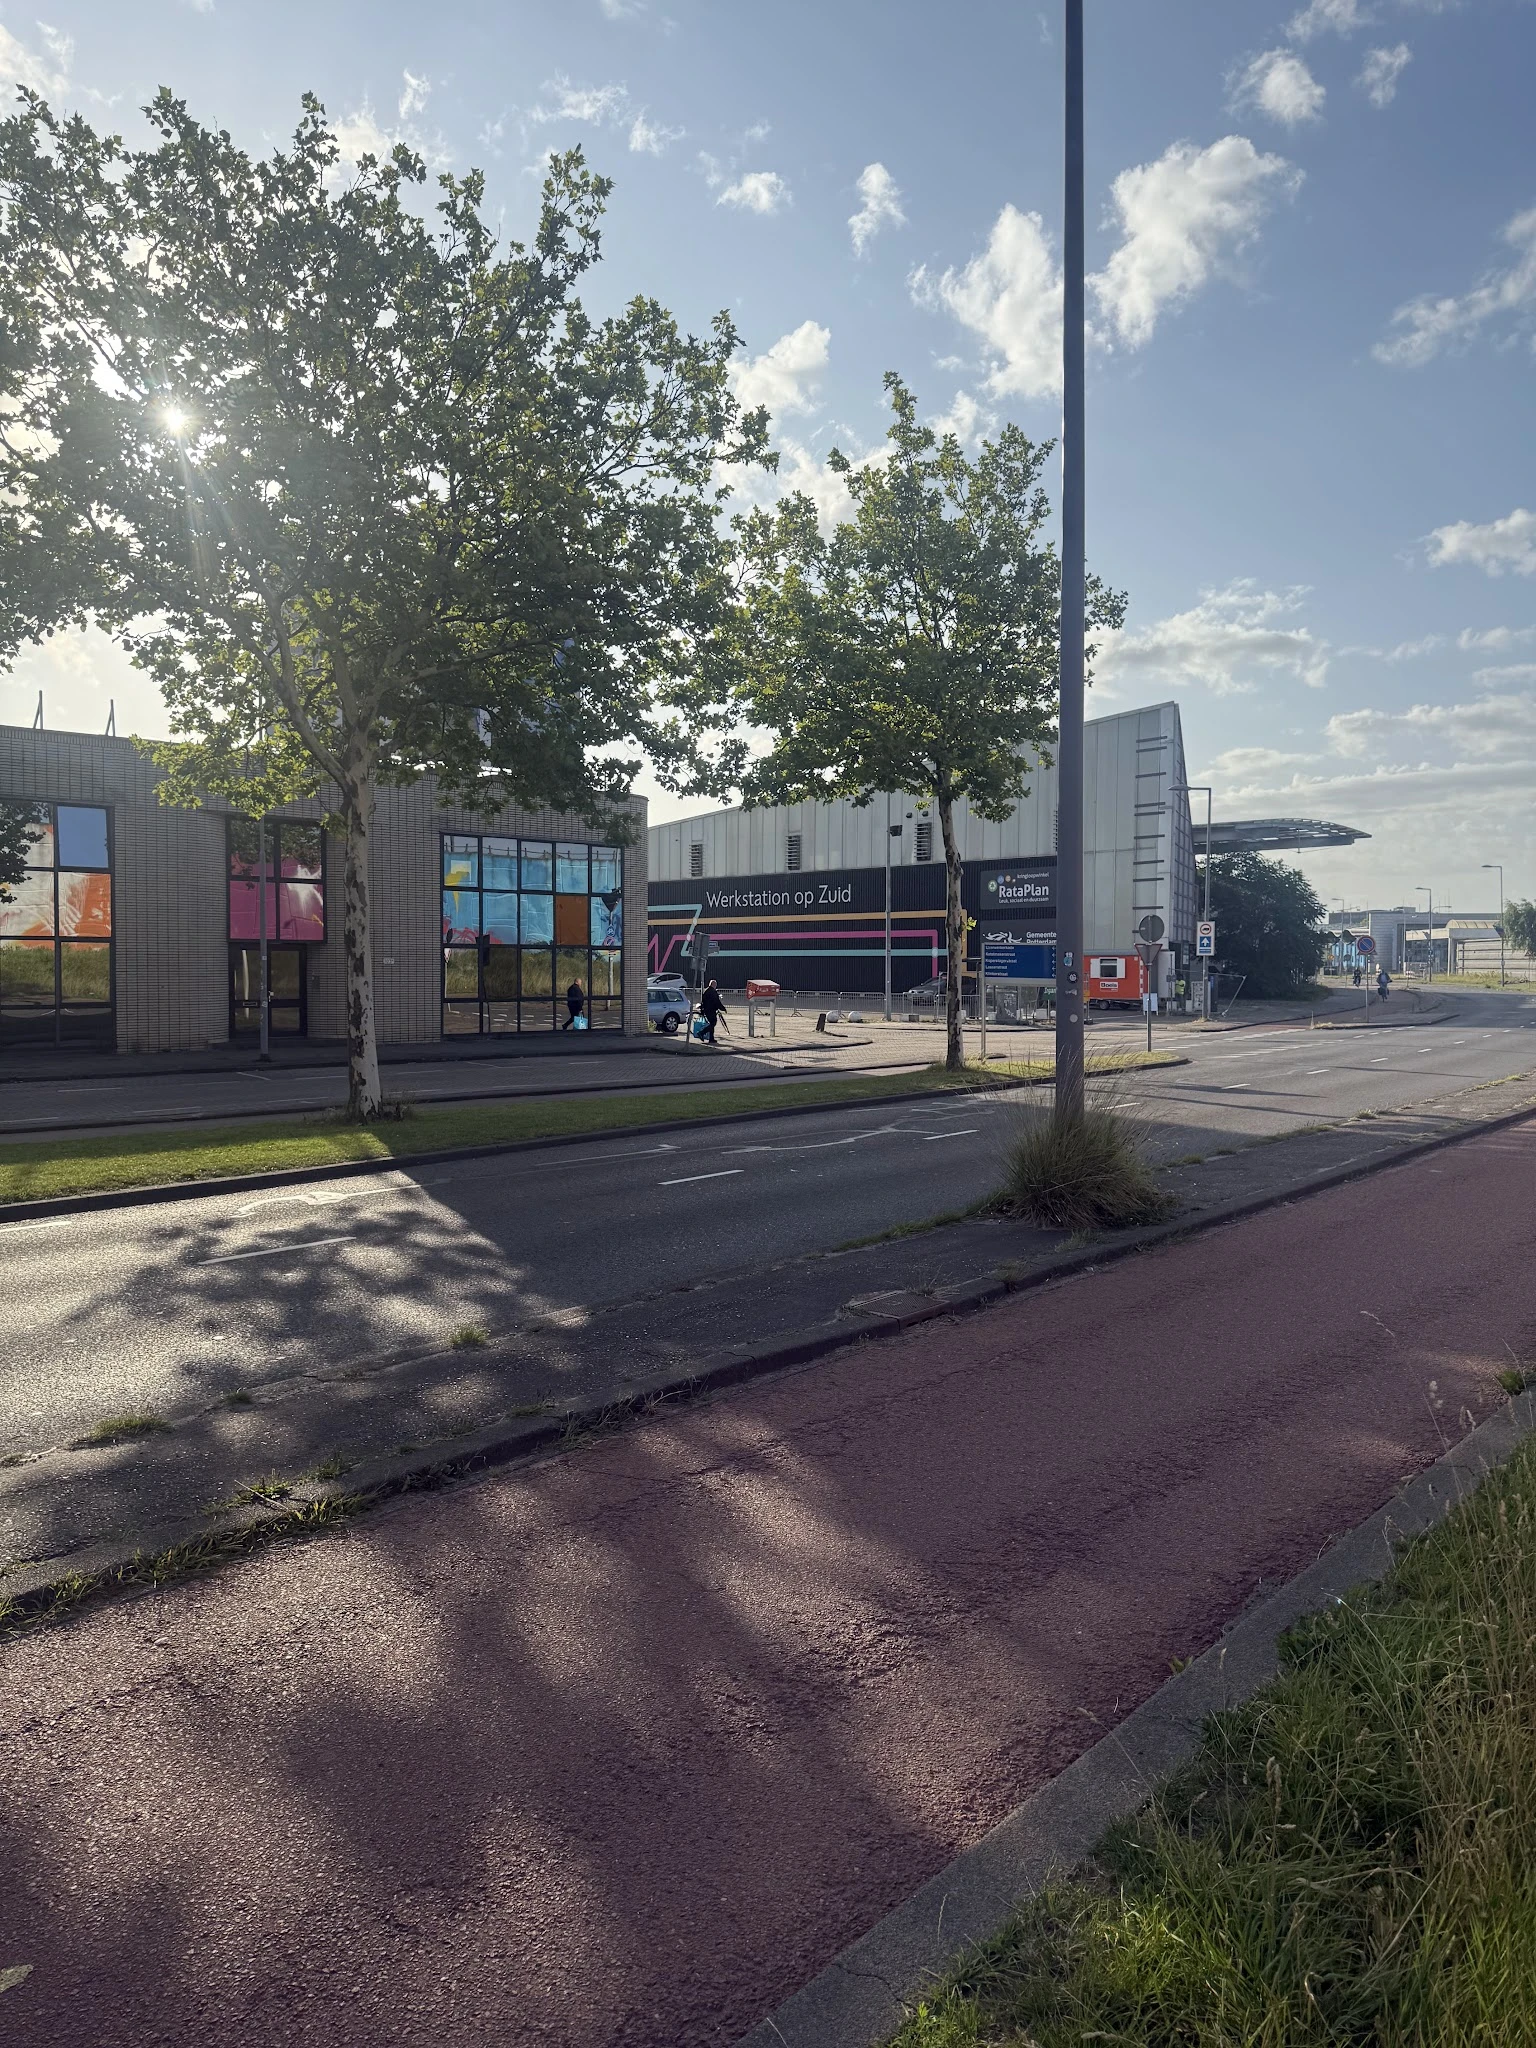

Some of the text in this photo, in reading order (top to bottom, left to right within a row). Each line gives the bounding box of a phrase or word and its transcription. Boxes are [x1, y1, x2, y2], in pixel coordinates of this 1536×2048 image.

[706, 883, 851, 909] Werkstation op Zuid
[999, 883, 1049, 898] RataPlan
[1026, 931, 1057, 939] Gemeente
